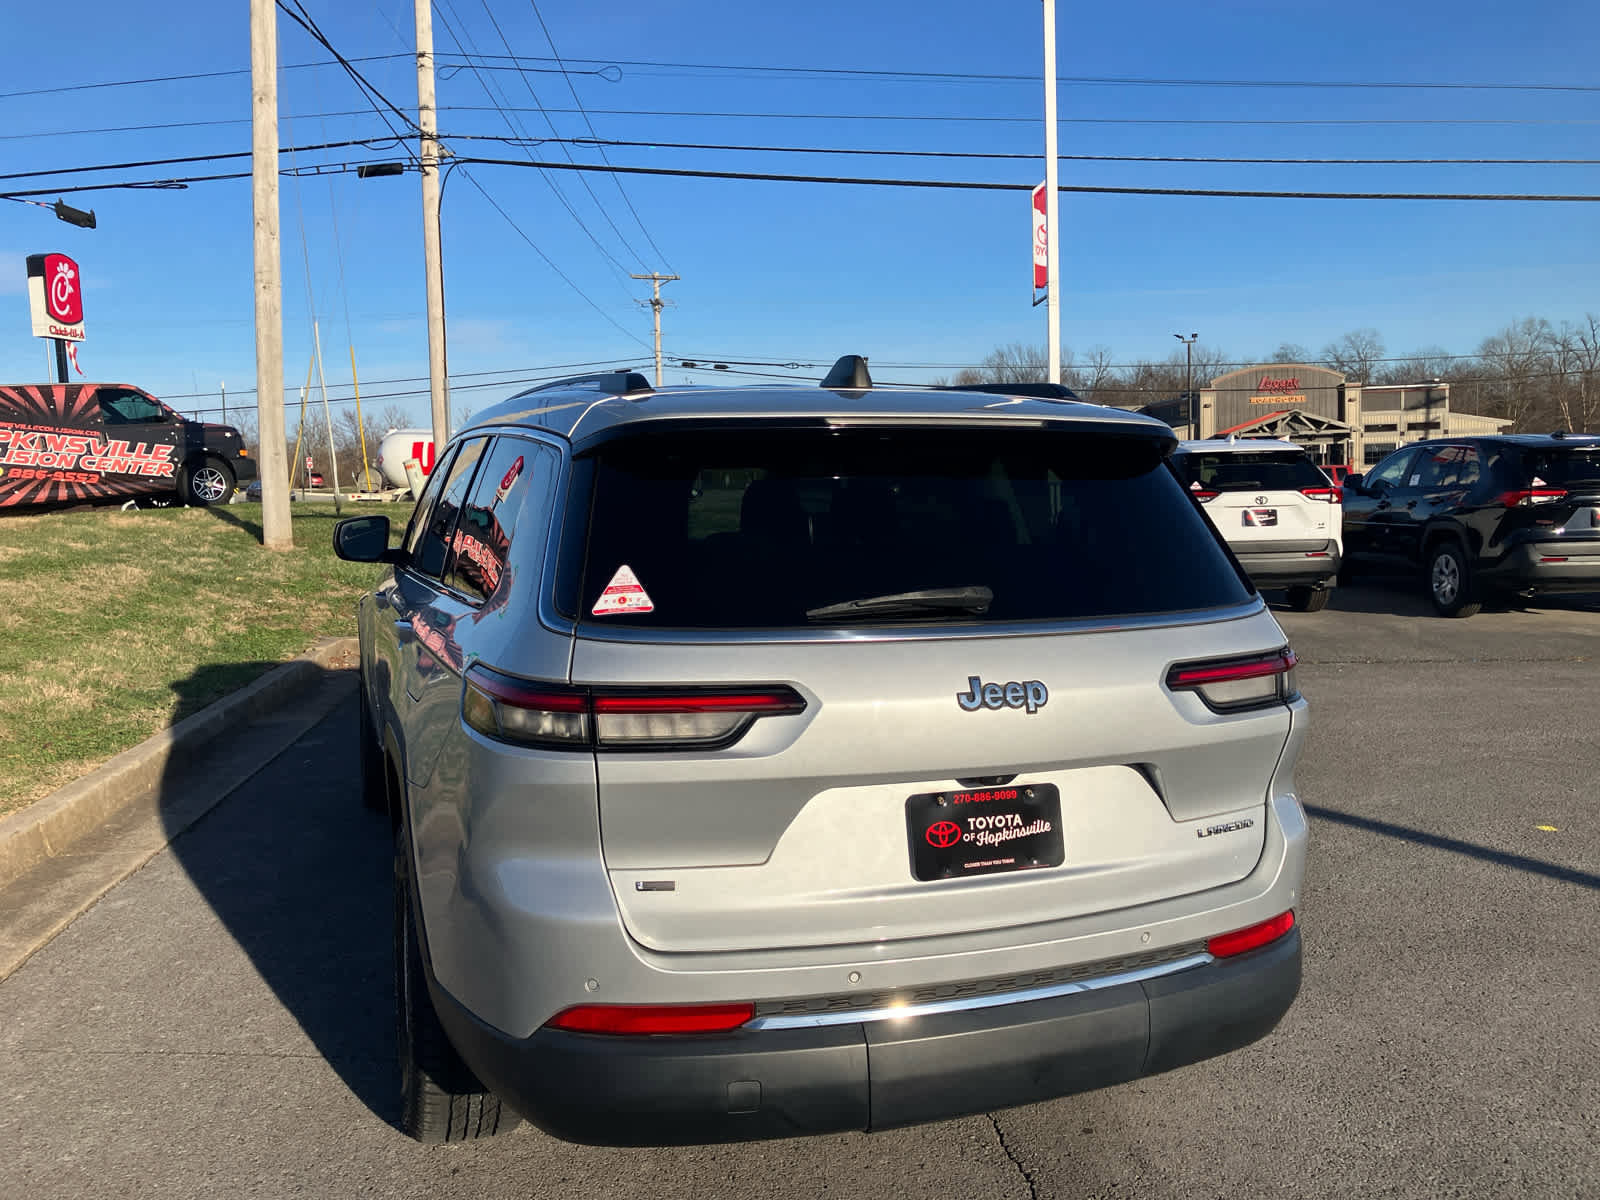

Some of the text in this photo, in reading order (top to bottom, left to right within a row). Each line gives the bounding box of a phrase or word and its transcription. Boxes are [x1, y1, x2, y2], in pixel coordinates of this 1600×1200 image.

[79, 456, 175, 477] CENTER
[956, 676, 1048, 714] Jeep
[953, 790, 1017, 804] 270-886-9099
[968, 814, 1023, 830] TOYOTA
[963, 819, 1052, 847] OF Hopkinsville
